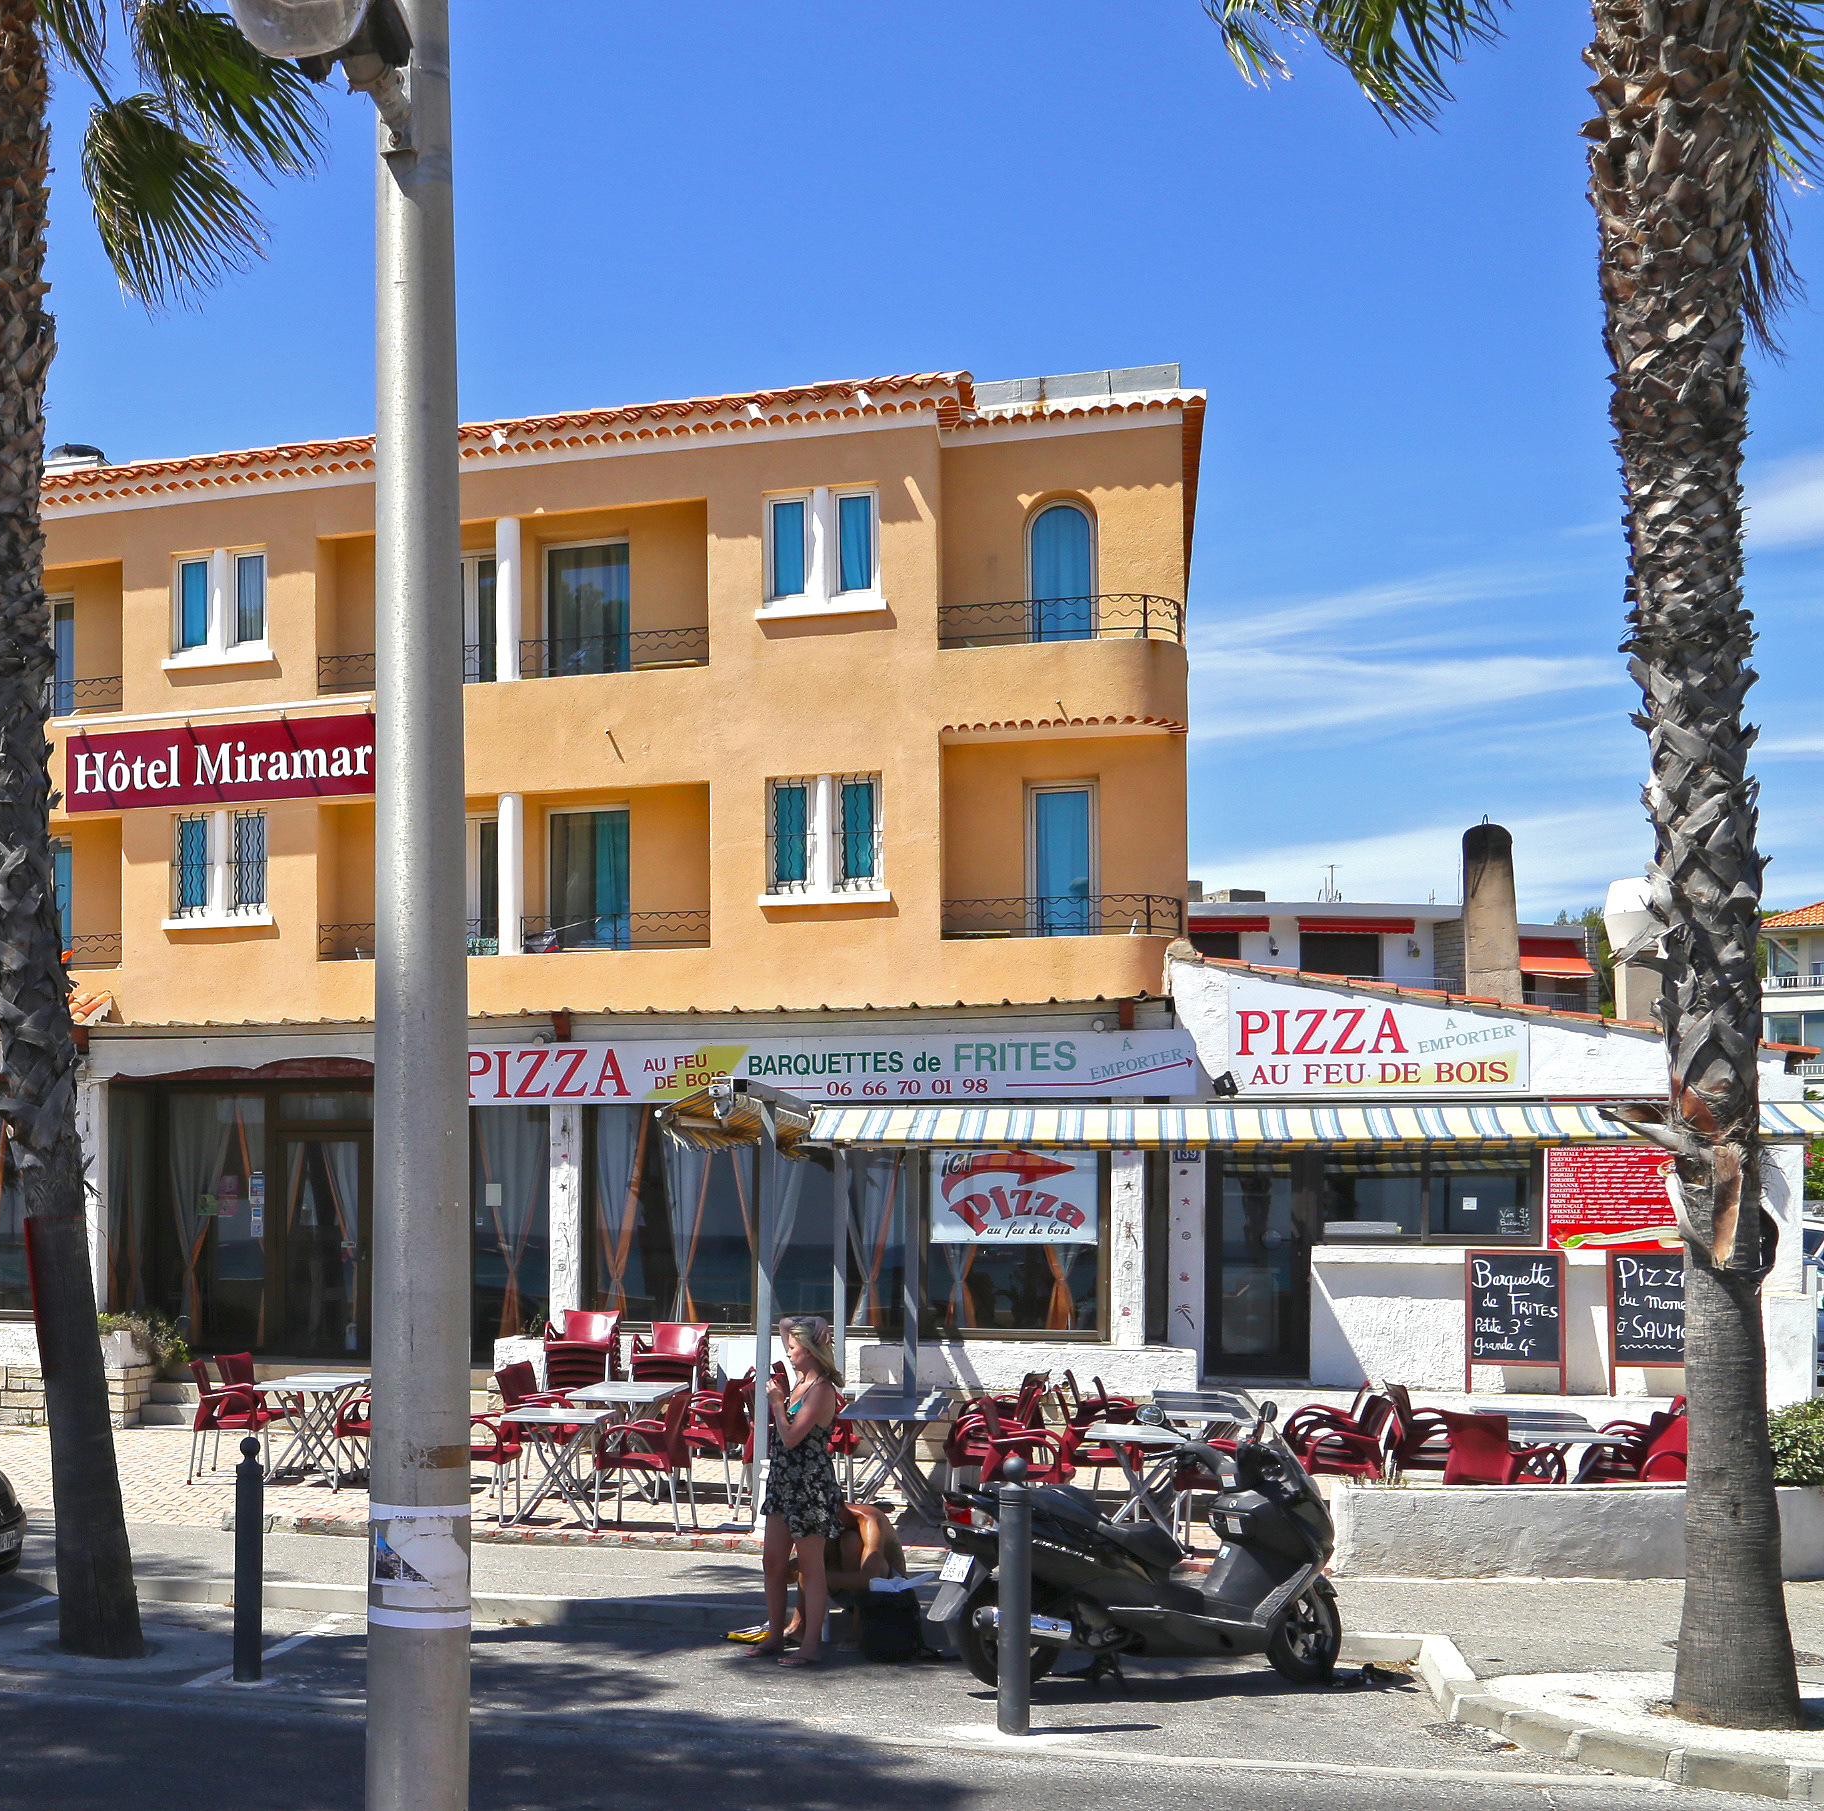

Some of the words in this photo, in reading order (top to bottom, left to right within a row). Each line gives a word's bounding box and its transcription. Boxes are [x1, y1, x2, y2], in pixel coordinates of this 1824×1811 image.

[74, 744, 182, 794] Hôtel
[193, 741, 373, 786] Miramar
[1236, 1008, 1409, 1055] PIZZA
[1418, 1024, 1516, 1054] EMPORTER
[643, 1057, 667, 1072] AU
[674, 1053, 708, 1070] FEU
[748, 1051, 904, 1076] BARQUETTES
[913, 1052, 941, 1072] de
[954, 1041, 1077, 1072] FRITES
[1089, 1048, 1183, 1080] EMPORTER
[468, 1048, 631, 1099] PIZZA
[655, 1075, 678, 1090] DE
[686, 1071, 728, 1088] BOIS
[1249, 1064, 1291, 1085] AU
[1303, 1063, 1366, 1084] FEU
[1379, 1062, 1422, 1084] DE
[1434, 1061, 1509, 1083] BOIS
[827, 1080, 852, 1096] 06
[862, 1080, 888, 1096] 66
[897, 1080, 921, 1095] 70
[931, 1079, 952, 1095] 01
[962, 1078, 989, 1094] 98
[1177, 1149, 1198, 1159] 139
[948, 1186, 1086, 1236] Pizza
[1005, 1221, 1025, 1238] feu
[1028, 1222, 1043, 1235] de
[1047, 1221, 1071, 1235] bois
[1472, 1259, 1555, 1294] Barquette
[1482, 1292, 1499, 1308] de
[1619, 1290, 1640, 1307] du
[1475, 1317, 1505, 1335] Petite
